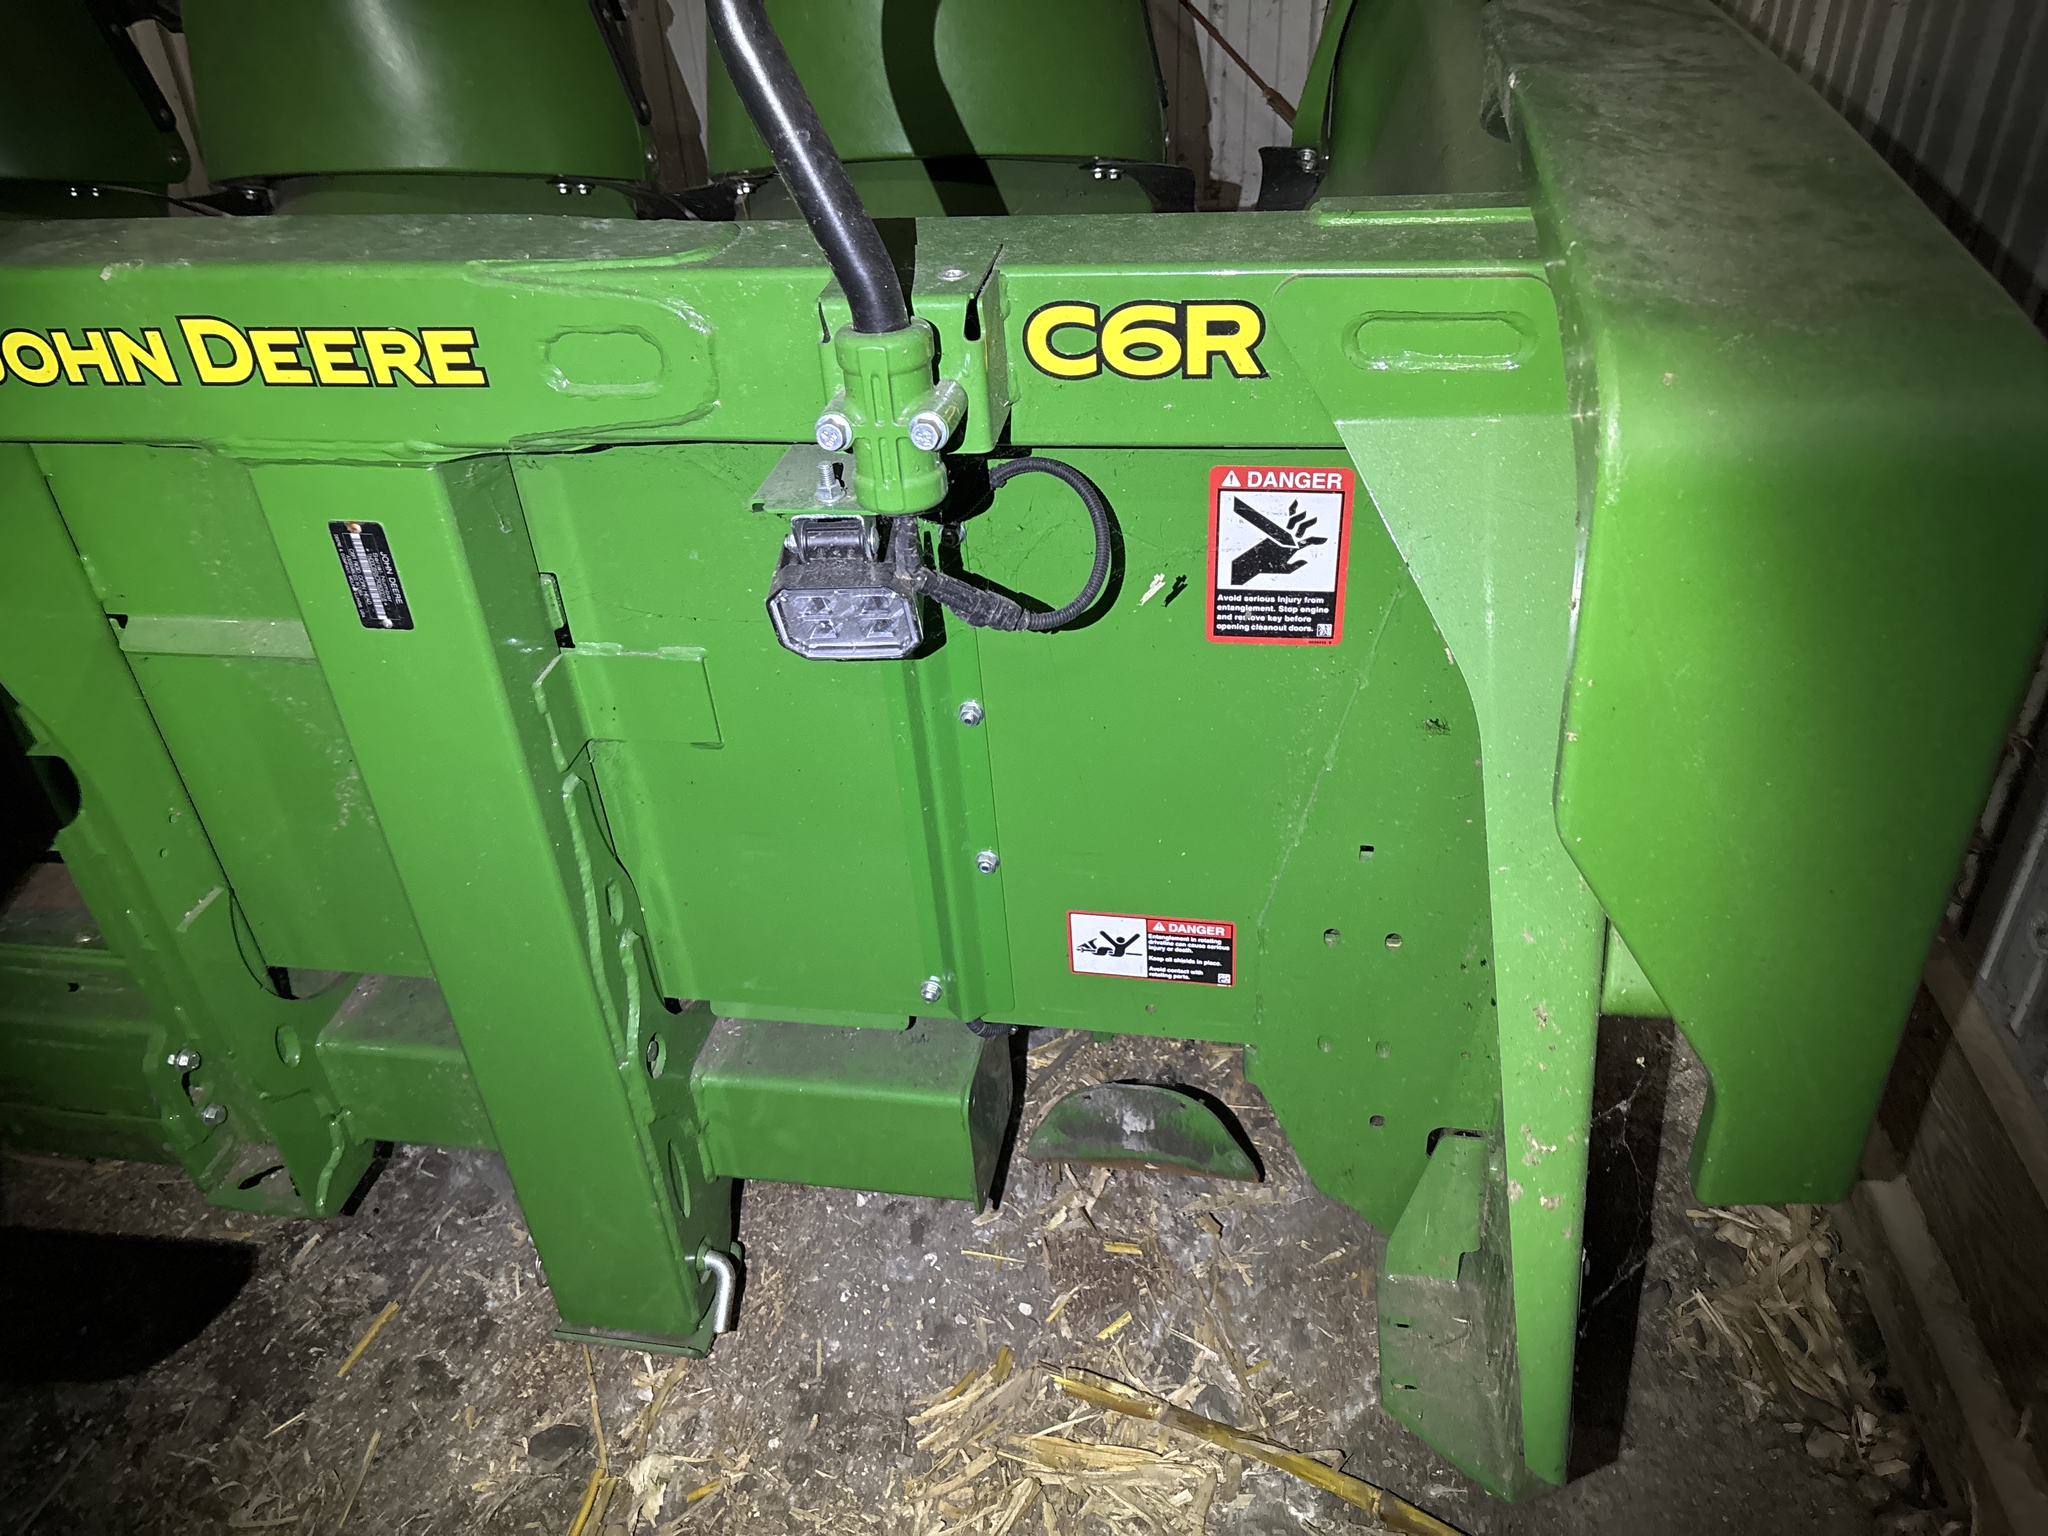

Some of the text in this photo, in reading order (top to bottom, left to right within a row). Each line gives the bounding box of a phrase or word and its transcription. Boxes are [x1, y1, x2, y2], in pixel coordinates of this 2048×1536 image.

[1023, 300, 1271, 380] C6R
[0, 315, 489, 387] OHN DEERE
[1247, 471, 1342, 489] DANGER
[372, 552, 383, 574] Serial
[380, 575, 393, 603] Number
[380, 551, 403, 604] JOHN DEERE
[1217, 594, 1324, 605] Avoid serious injury from
[1216, 604, 1329, 615] entanglement. Stop engine
[1267, 614, 1282, 623] key
[1284, 615, 1312, 623] before
[1216, 623, 1250, 631] opening
[1168, 923, 1225, 936] DANGER
[1148, 933, 1190, 942] Entanglement
